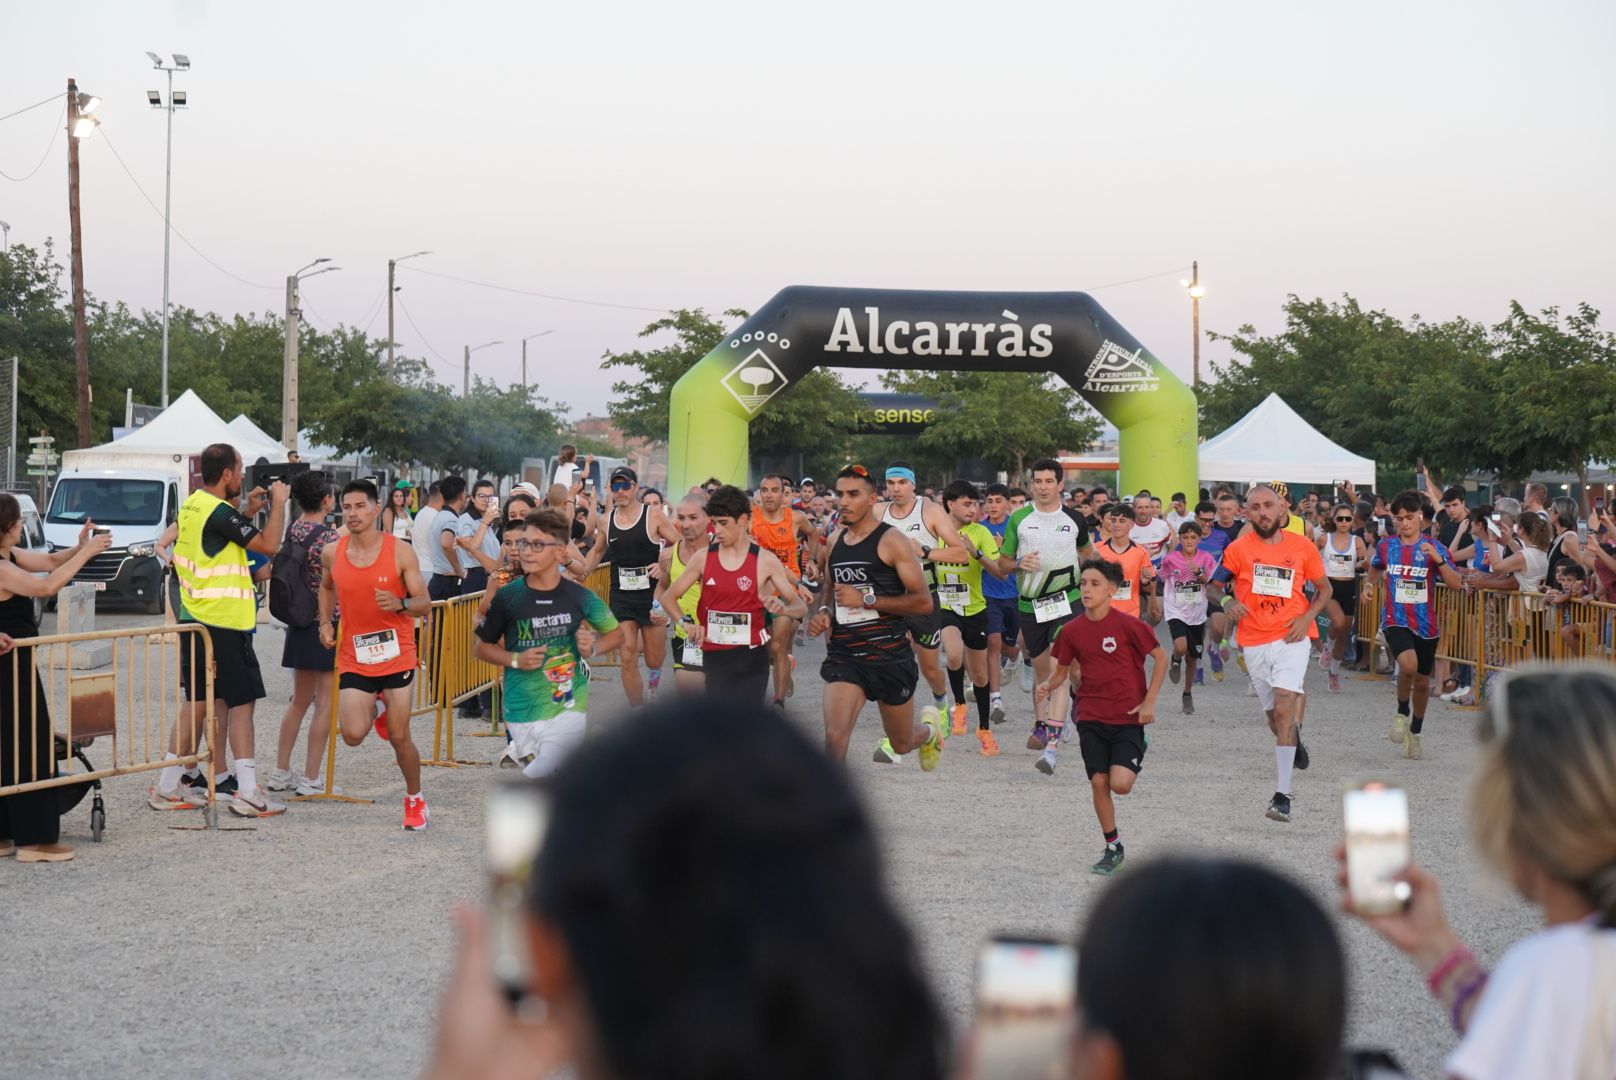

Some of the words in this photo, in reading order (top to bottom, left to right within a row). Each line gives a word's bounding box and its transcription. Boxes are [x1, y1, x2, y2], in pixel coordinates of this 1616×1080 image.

[824, 307, 1053, 357] Alcarràs
[1100, 371, 1142, 379] D'ESPORTS
[1082, 380, 1159, 393] Alcarràs
[833, 567, 868, 583] PONS
[1264, 577, 1281, 586] 651
[532, 612, 572, 628] Nectarina
[719, 625, 737, 634] 733
[368, 644, 384, 653] 111
